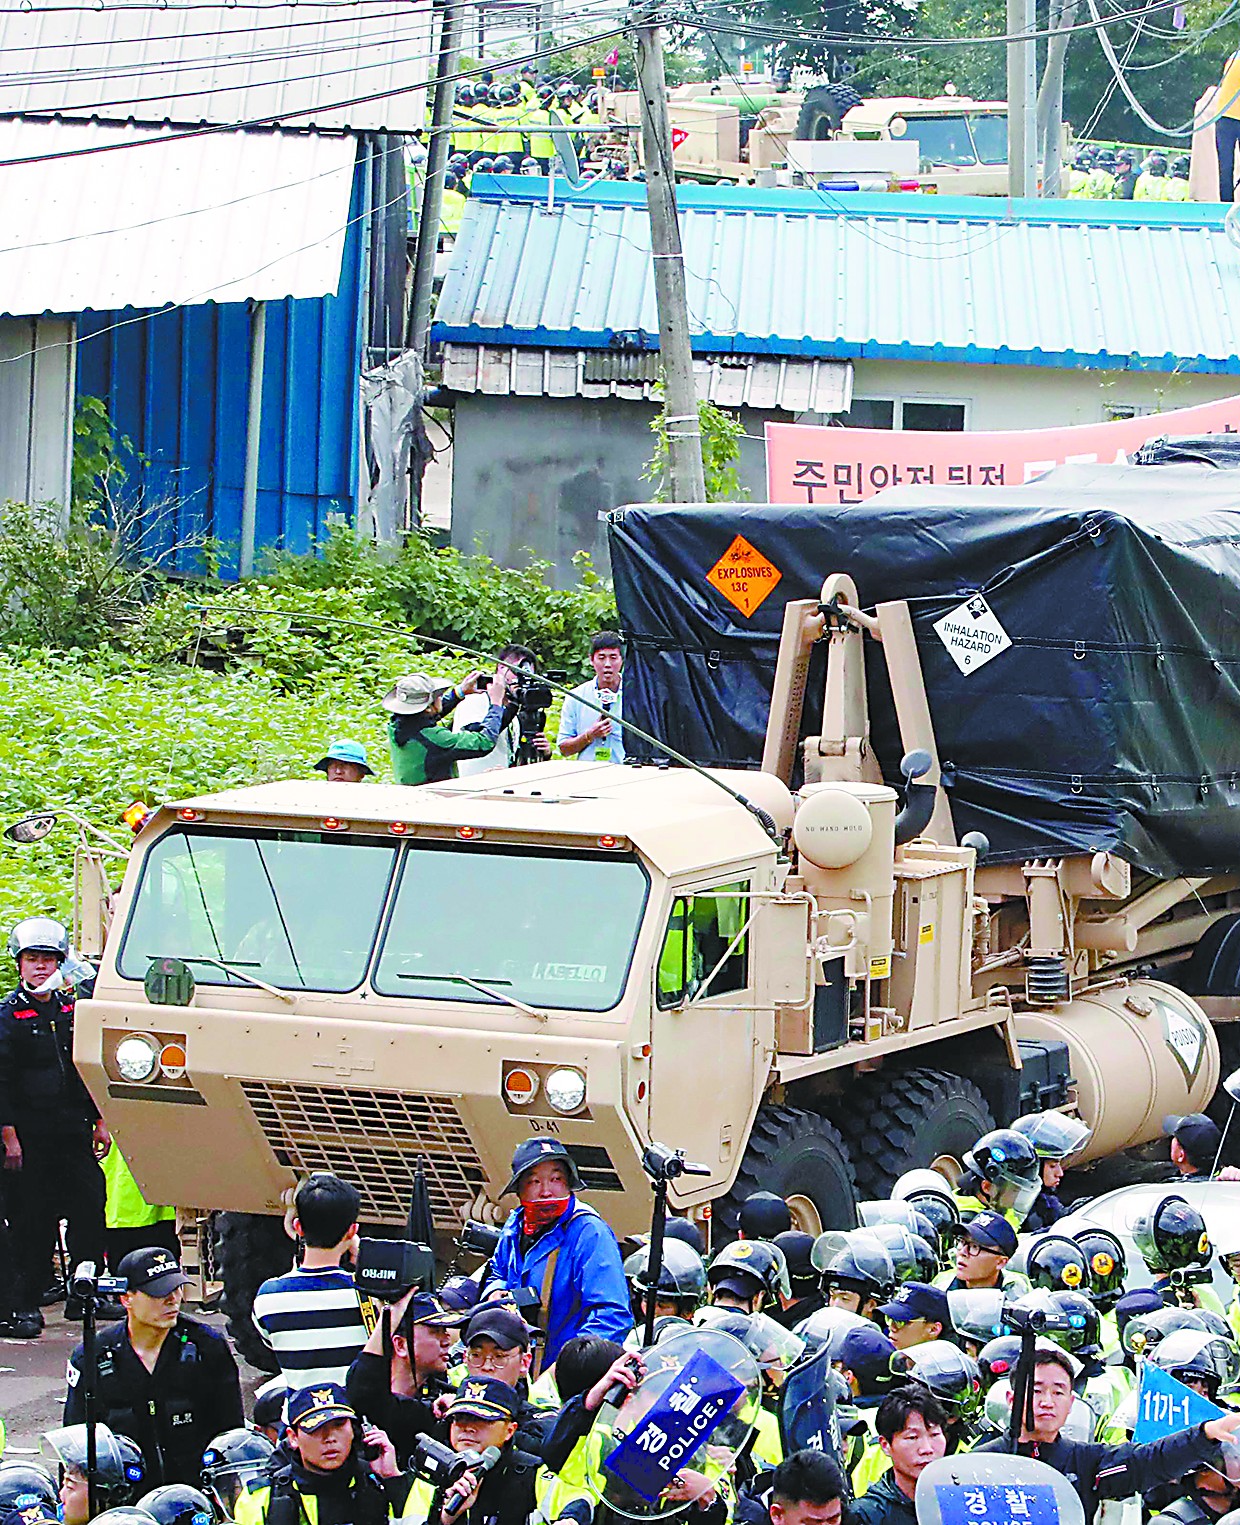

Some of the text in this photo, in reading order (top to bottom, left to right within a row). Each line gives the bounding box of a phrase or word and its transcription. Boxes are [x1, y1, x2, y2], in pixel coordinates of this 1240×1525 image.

[717, 566, 773, 580] EXPLOSIVES
[743, 597, 750, 609] 1
[943, 622, 1003, 645] INHALATION
[950, 636, 991, 654] HAZARD
[964, 655, 972, 665] 6
[1171, 1028, 1199, 1048] POISON
[529, 1119, 560, 1133] D-41
[147, 1261, 179, 1277] POLICE
[362, 1268, 397, 1280] MIPRO
[1143, 1390, 1191, 1426] 11가-1
[636, 1381, 702, 1454] 경찰
[658, 1404, 719, 1472] POLICE
[963, 1487, 1032, 1519] 경찰
